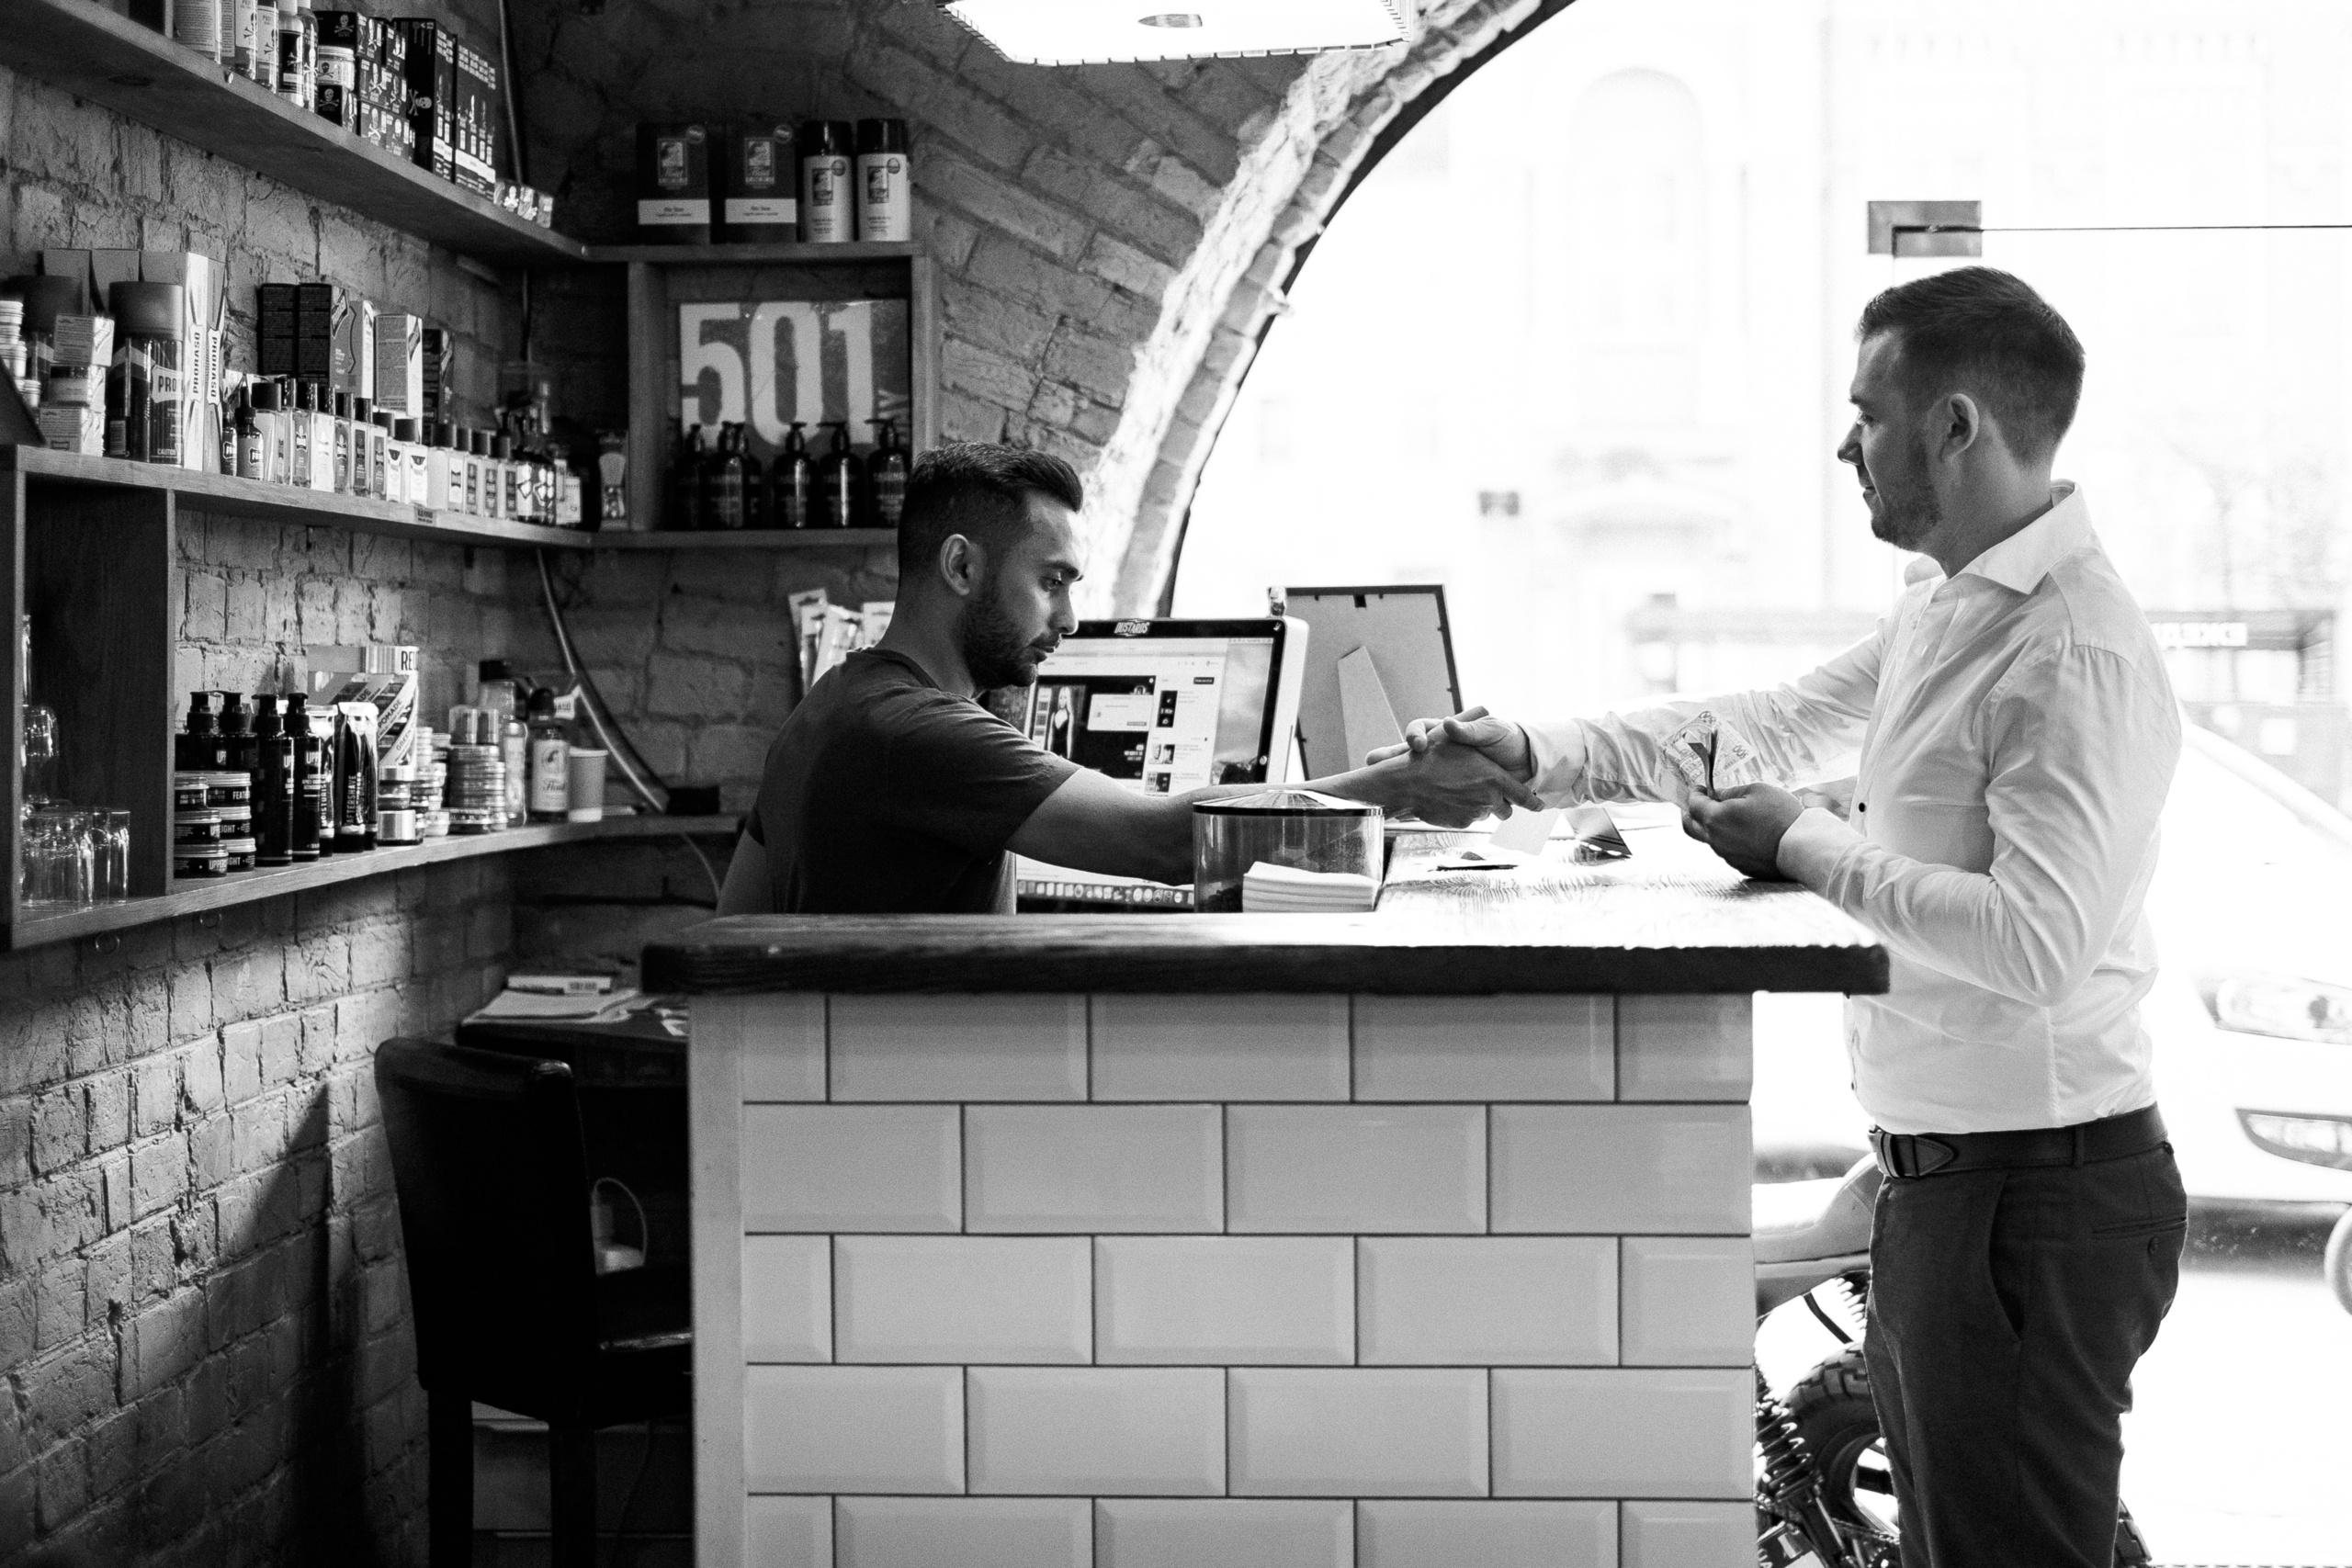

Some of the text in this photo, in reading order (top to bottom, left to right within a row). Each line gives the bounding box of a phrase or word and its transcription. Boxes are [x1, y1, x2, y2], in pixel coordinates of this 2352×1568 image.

[192, 332, 200, 394] PRORASO
[681, 300, 874, 447] 501
[378, 699, 402, 728] POMADE
